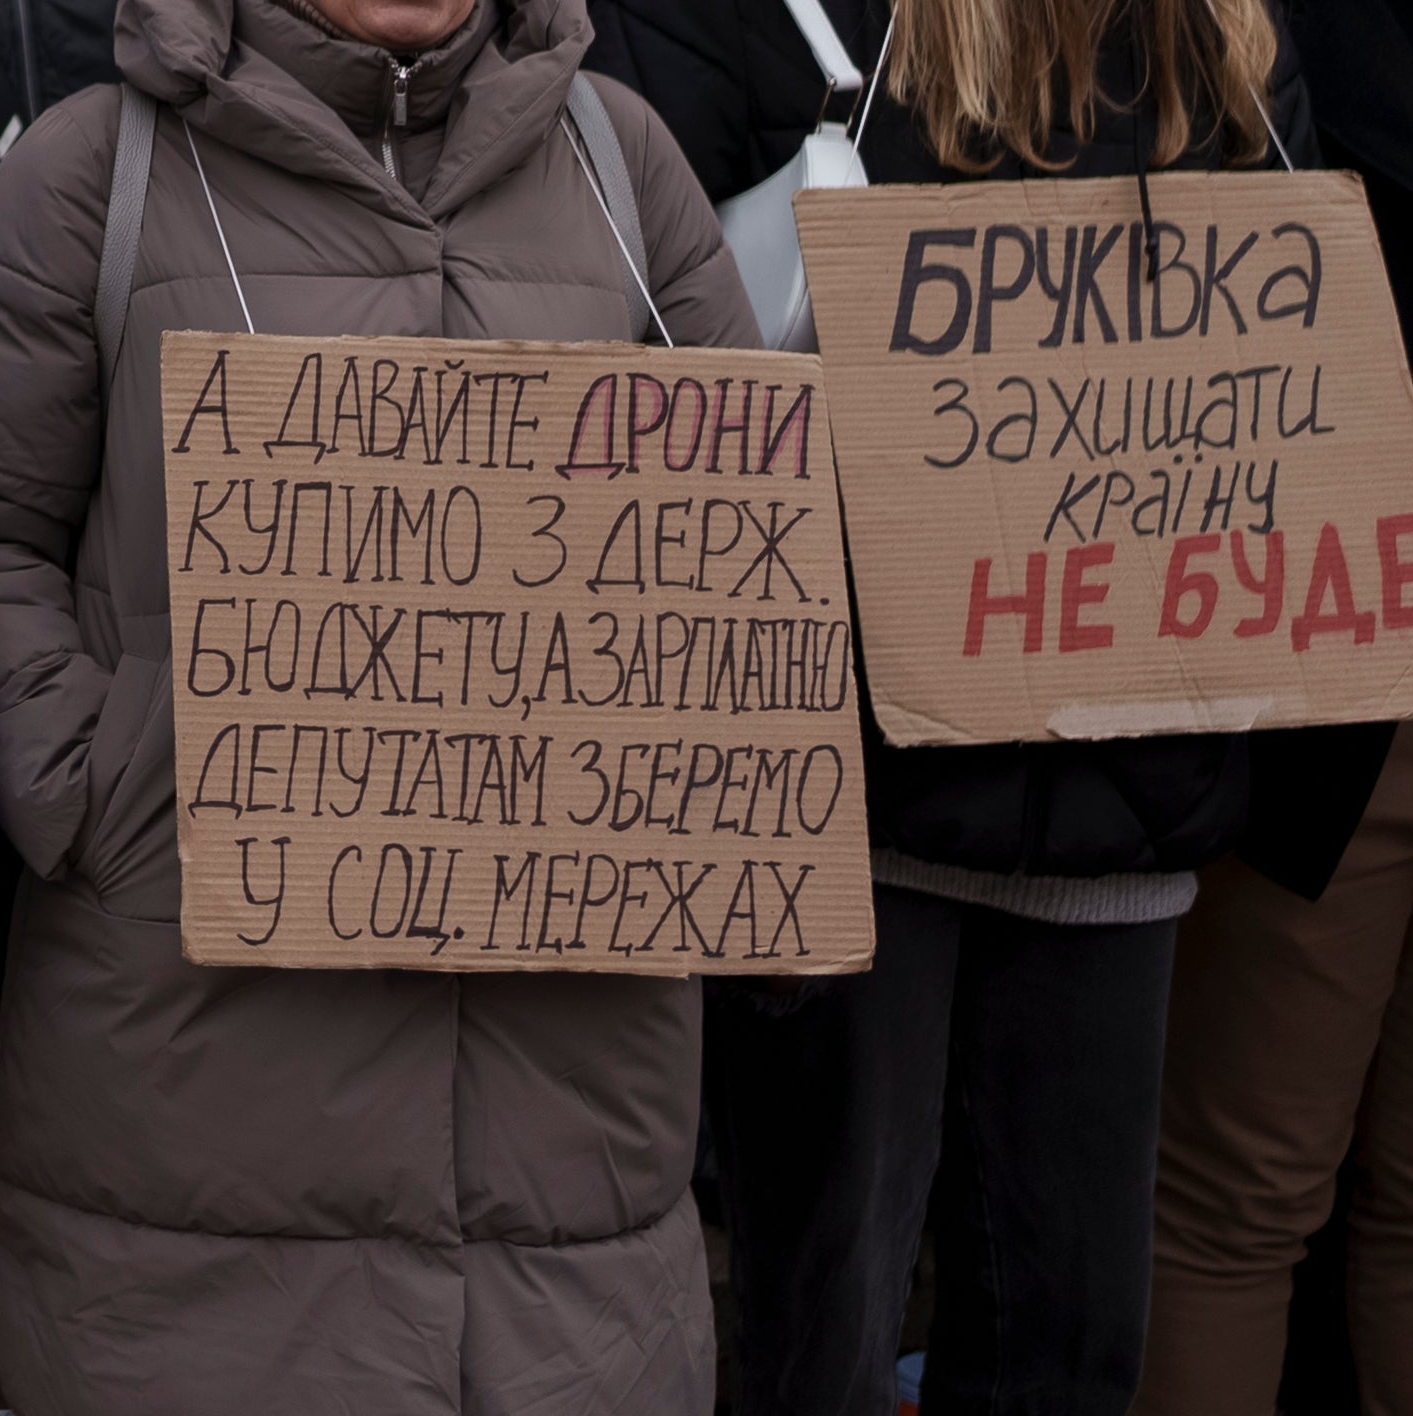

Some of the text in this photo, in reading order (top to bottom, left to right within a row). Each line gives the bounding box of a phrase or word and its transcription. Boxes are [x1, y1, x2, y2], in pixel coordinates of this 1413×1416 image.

[172, 350, 816, 480] А ДАВАЙТЕ ДРОНИ
[178, 478, 831, 606] КУПИМО З ДЕРЖ.
[962, 541, 1116, 657] НЕ
[187, 722, 845, 838] ДЕПУТАТАМ ЗБЕРЕМО
[235, 836, 816, 959] У СОЦ. МЕРЕЖАХ
